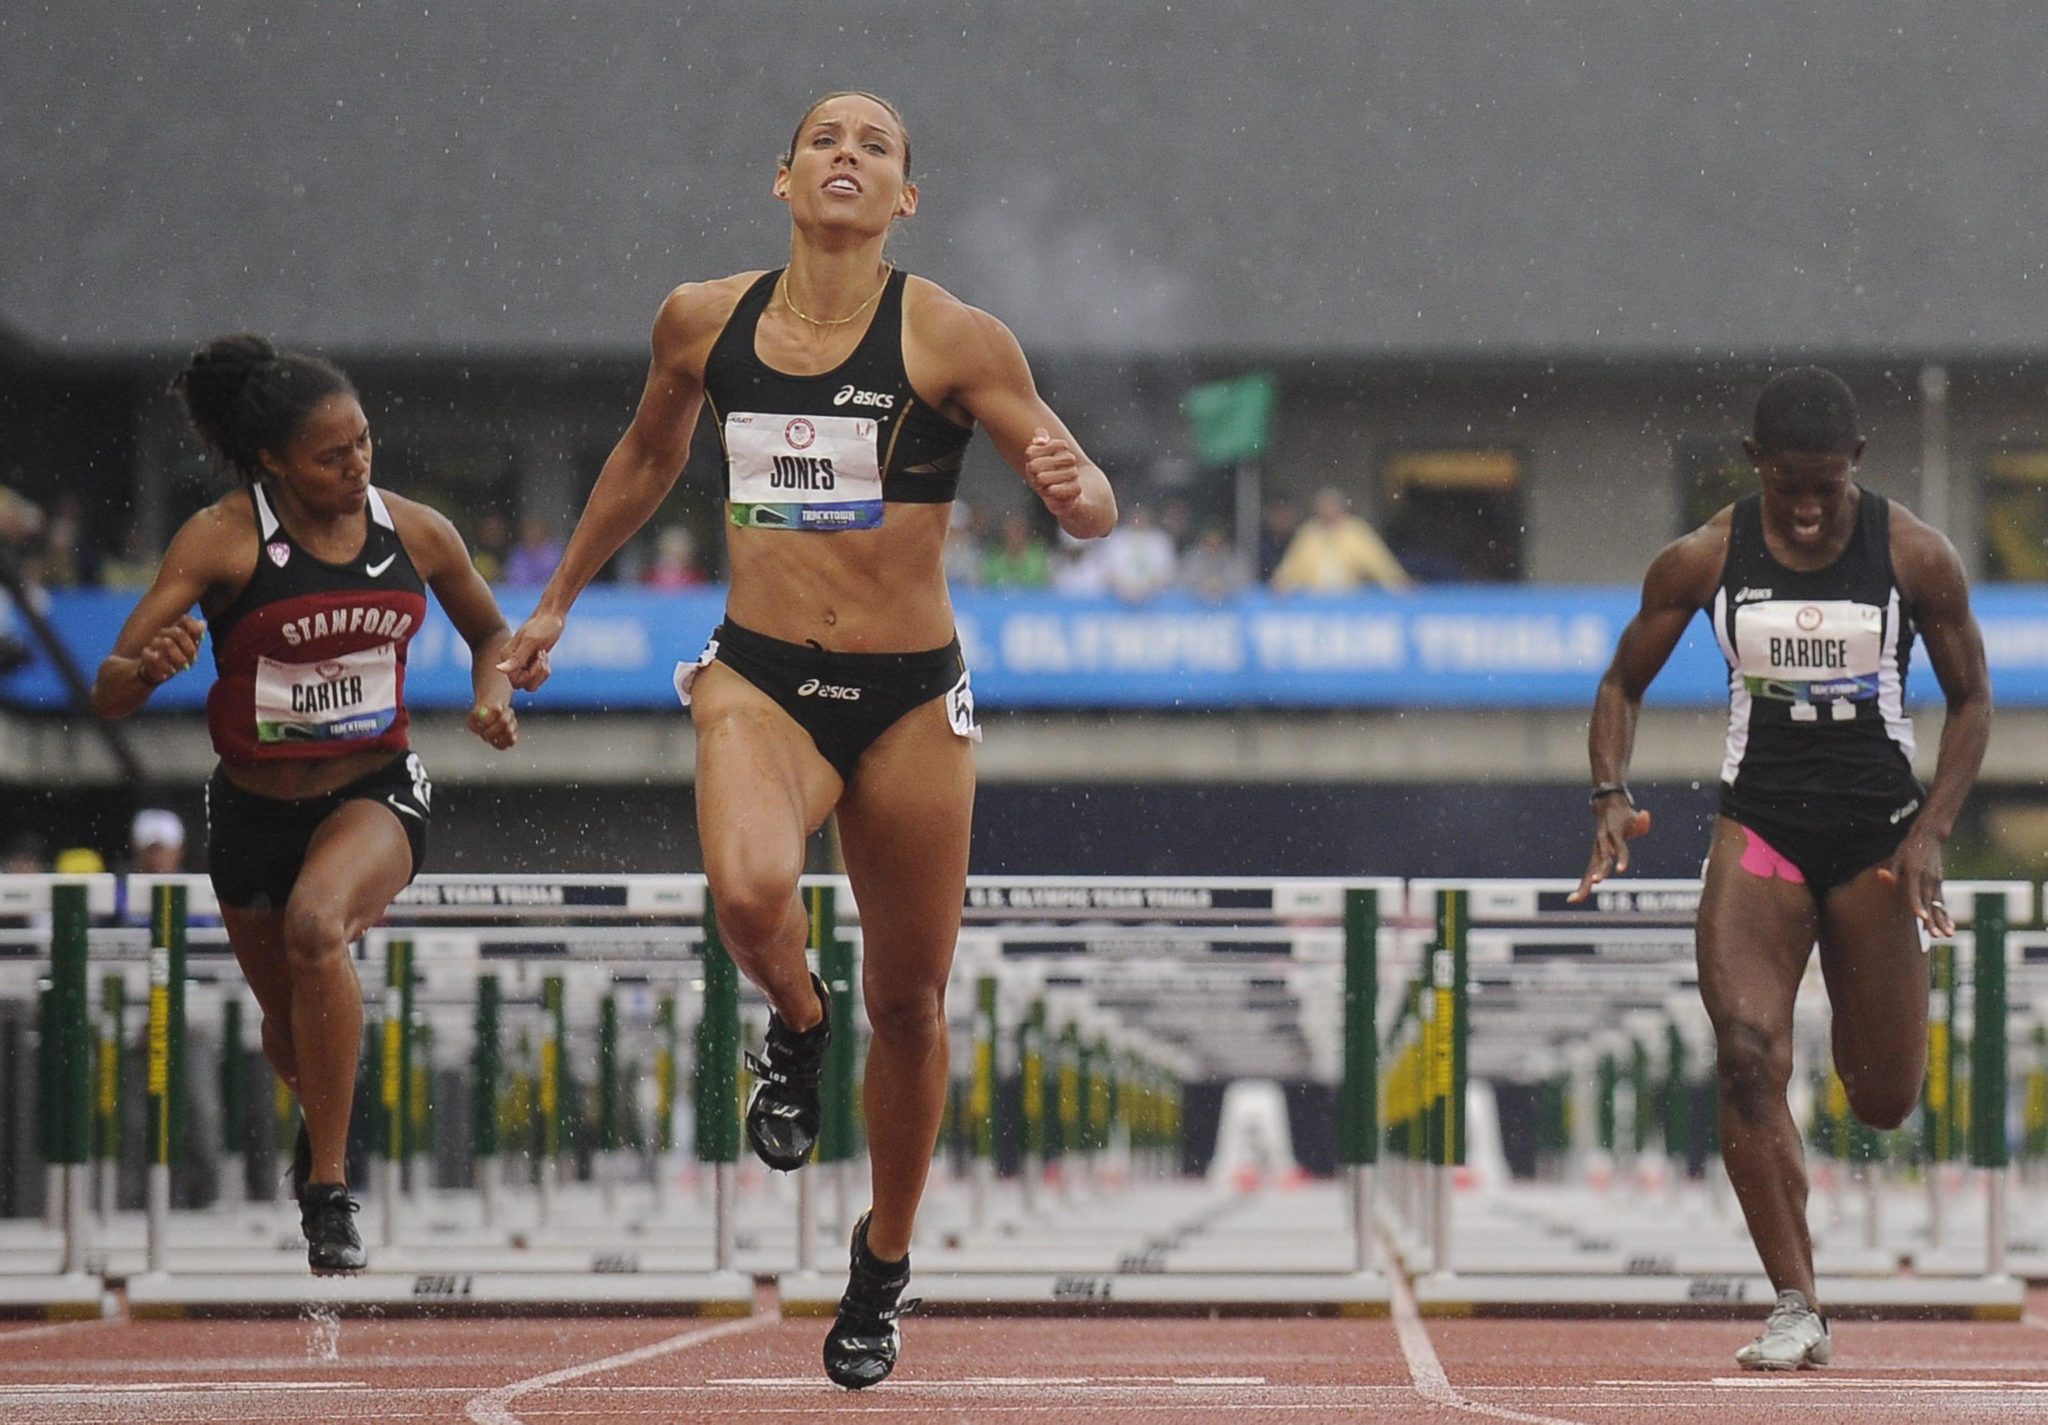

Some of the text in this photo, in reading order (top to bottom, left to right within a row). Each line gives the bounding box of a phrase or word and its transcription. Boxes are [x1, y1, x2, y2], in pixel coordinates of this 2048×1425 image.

[852, 391, 895, 408] asics
[770, 455, 835, 490] JONES
[282, 608, 412, 646] STANFORD
[1770, 638, 1847, 668] BARDGE
[291, 675, 363, 713] CARTER
[817, 684, 861, 700] asics
